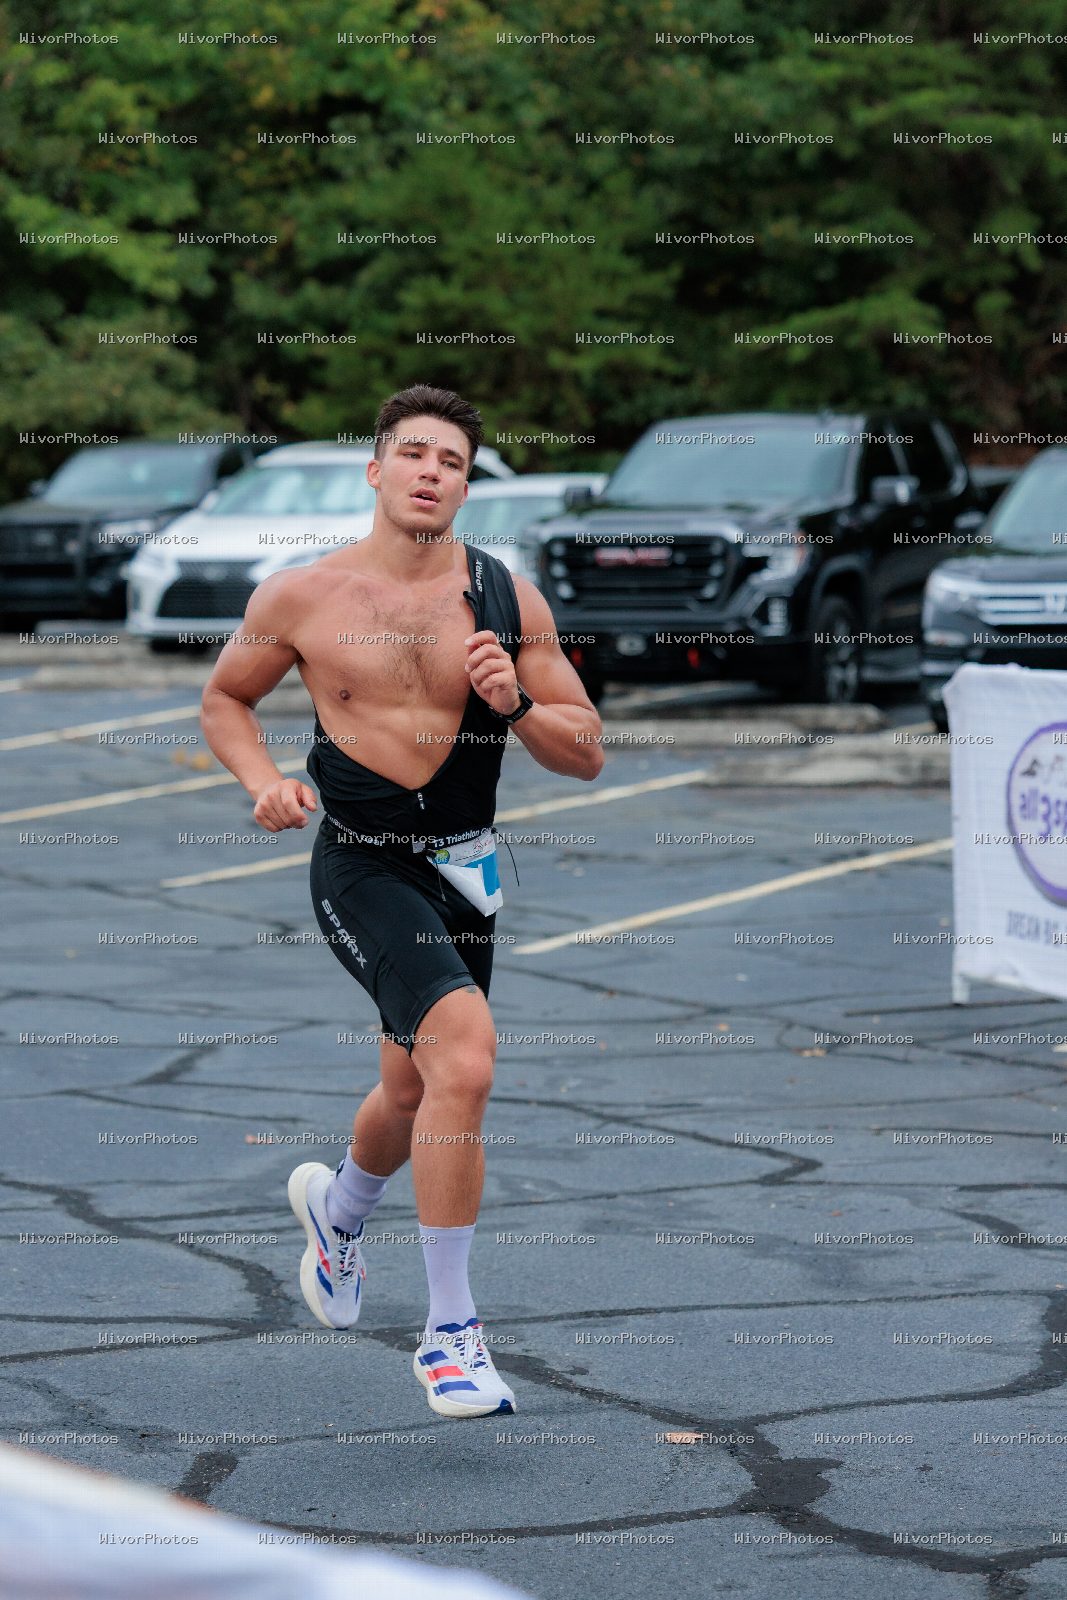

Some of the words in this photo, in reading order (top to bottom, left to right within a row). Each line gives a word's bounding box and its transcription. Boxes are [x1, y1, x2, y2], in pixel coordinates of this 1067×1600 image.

[432, 837, 445, 848] T3
[446, 829, 480, 845] Triathlon
[321, 898, 368, 970] SPARX
